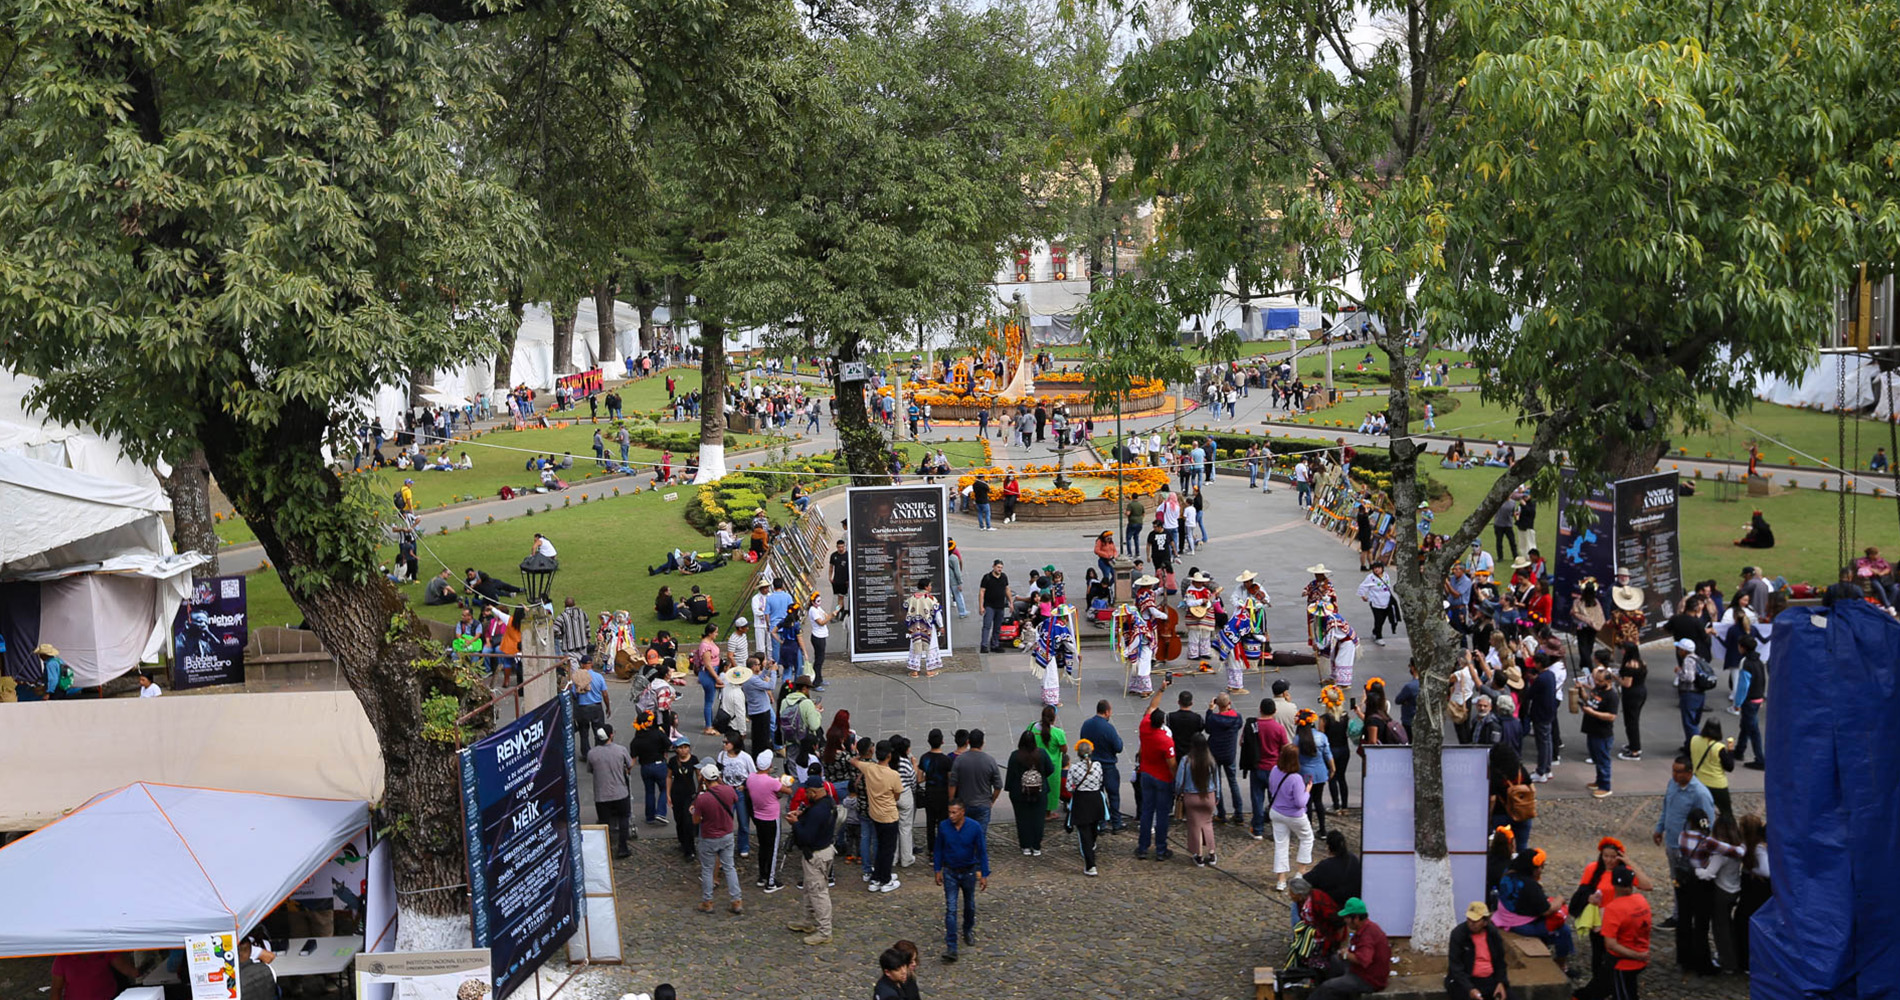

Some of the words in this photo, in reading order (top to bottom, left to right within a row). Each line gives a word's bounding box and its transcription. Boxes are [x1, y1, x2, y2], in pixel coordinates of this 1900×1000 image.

[896, 501, 927, 510] NOCHE
[898, 525, 923, 533] Cultural
[208, 614, 234, 624] nicho
[526, 782, 534, 792] UP
[405, 959, 431, 967] INSTITUTO
[431, 958, 457, 966] NACIONAL
[457, 956, 486, 965] ELECTORAL
